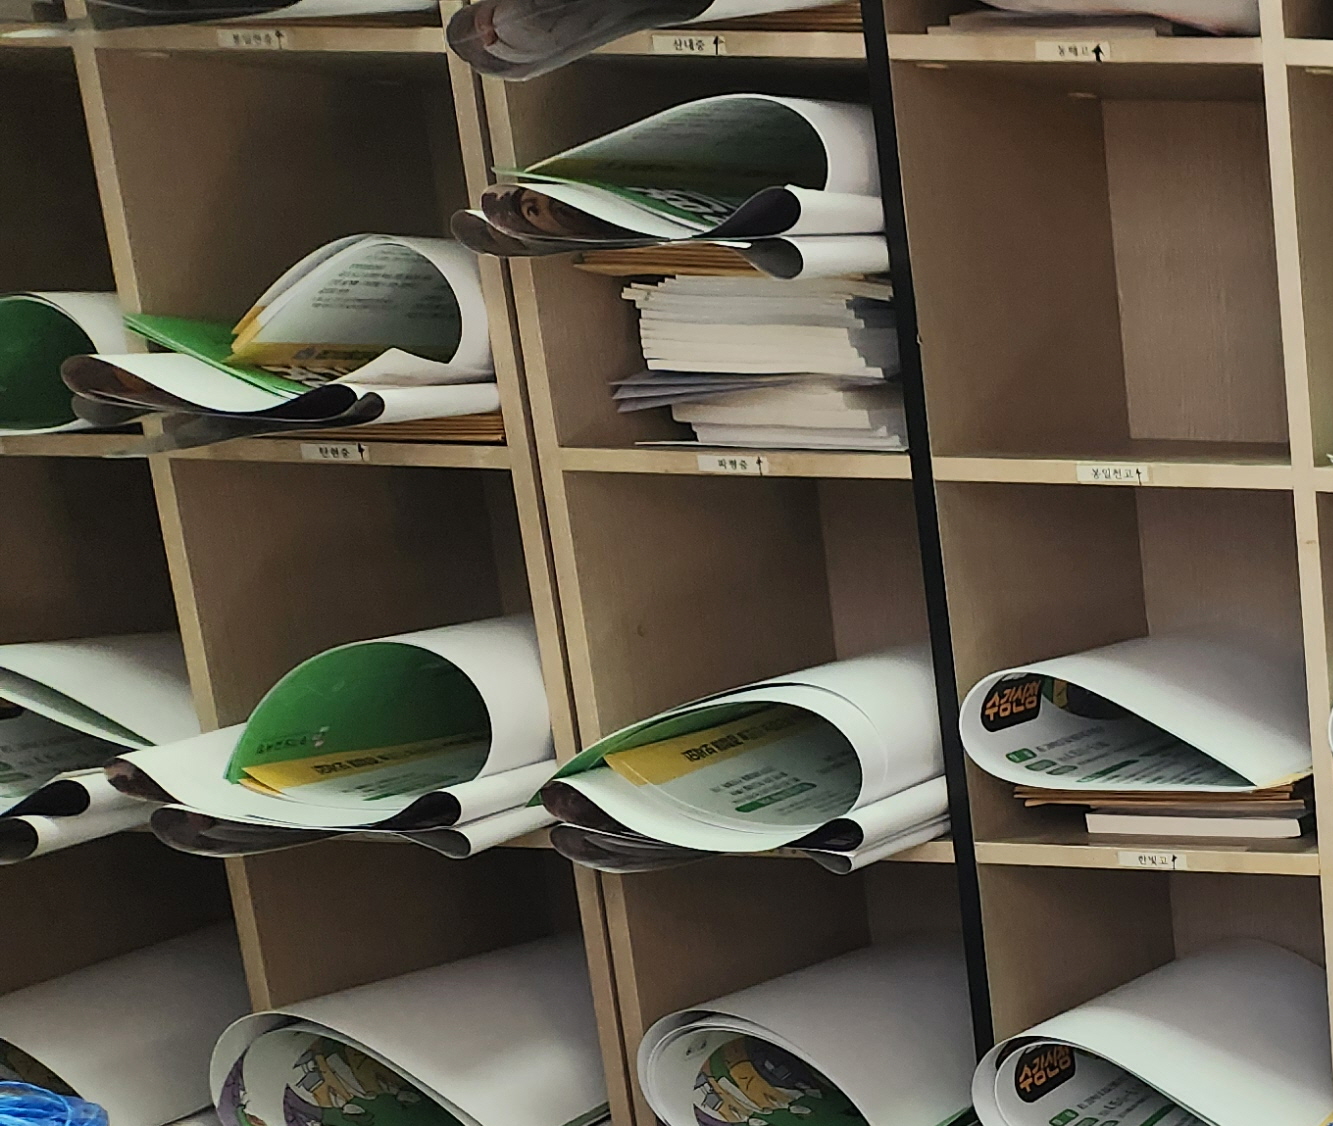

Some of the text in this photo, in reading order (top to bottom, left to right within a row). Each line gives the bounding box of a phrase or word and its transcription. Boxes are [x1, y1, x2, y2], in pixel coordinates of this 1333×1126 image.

[673, 38, 706, 51] 산내중
[1091, 467, 1135, 480] 봉일천고
[985, 681, 1040, 722] 수강신청
[1018, 1045, 1072, 1093] 수강신청
